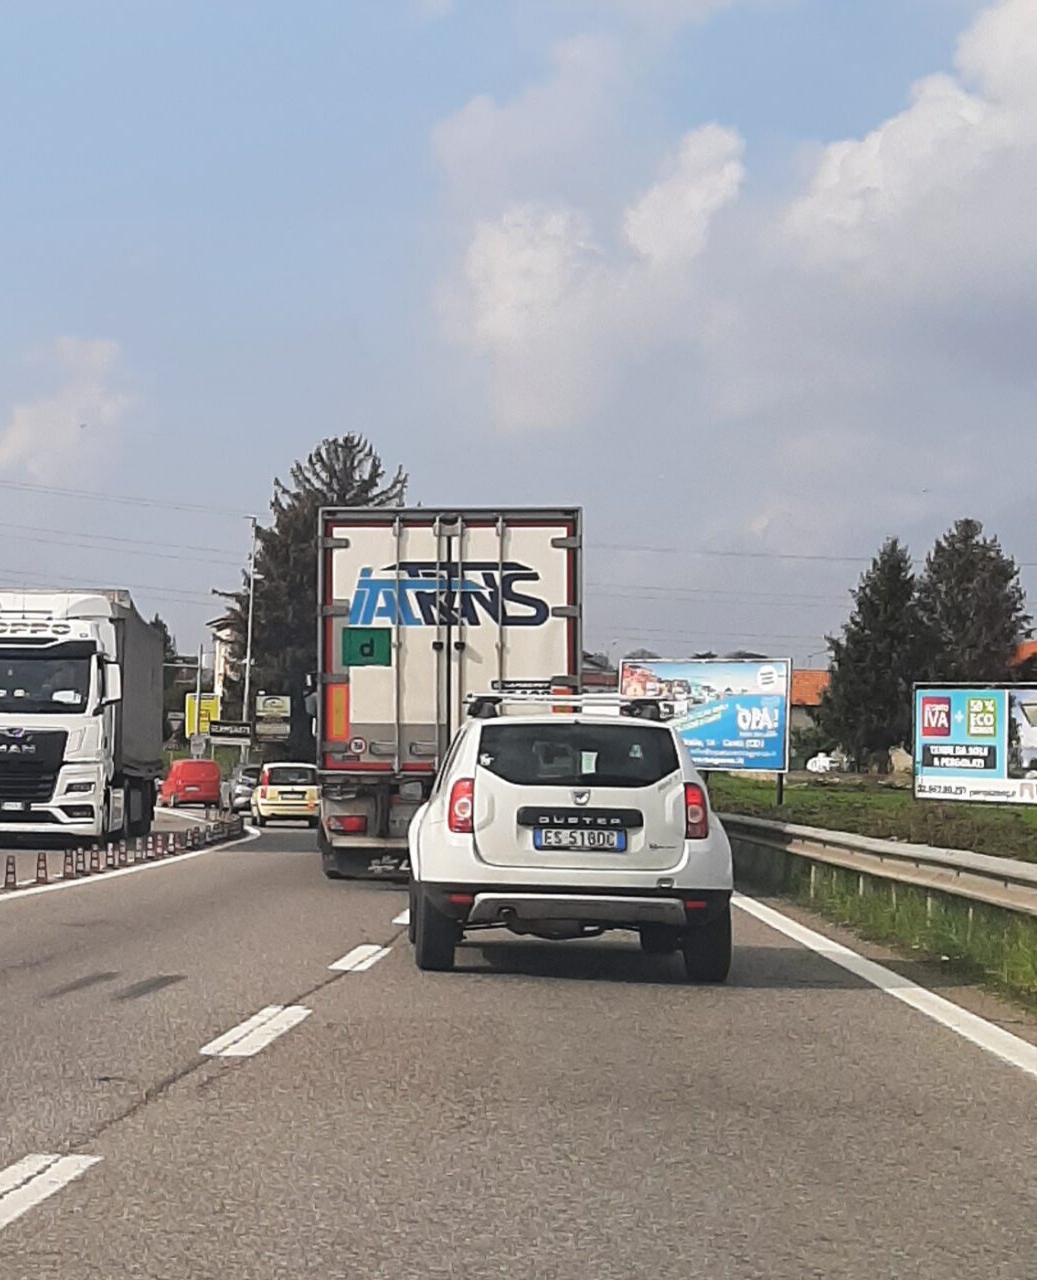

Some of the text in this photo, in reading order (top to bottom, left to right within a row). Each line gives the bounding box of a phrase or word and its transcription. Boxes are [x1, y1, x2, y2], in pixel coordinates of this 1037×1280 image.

[359, 639, 374, 658] d
[924, 709, 949, 728] IVA
[538, 815, 622, 825] DUSTER
